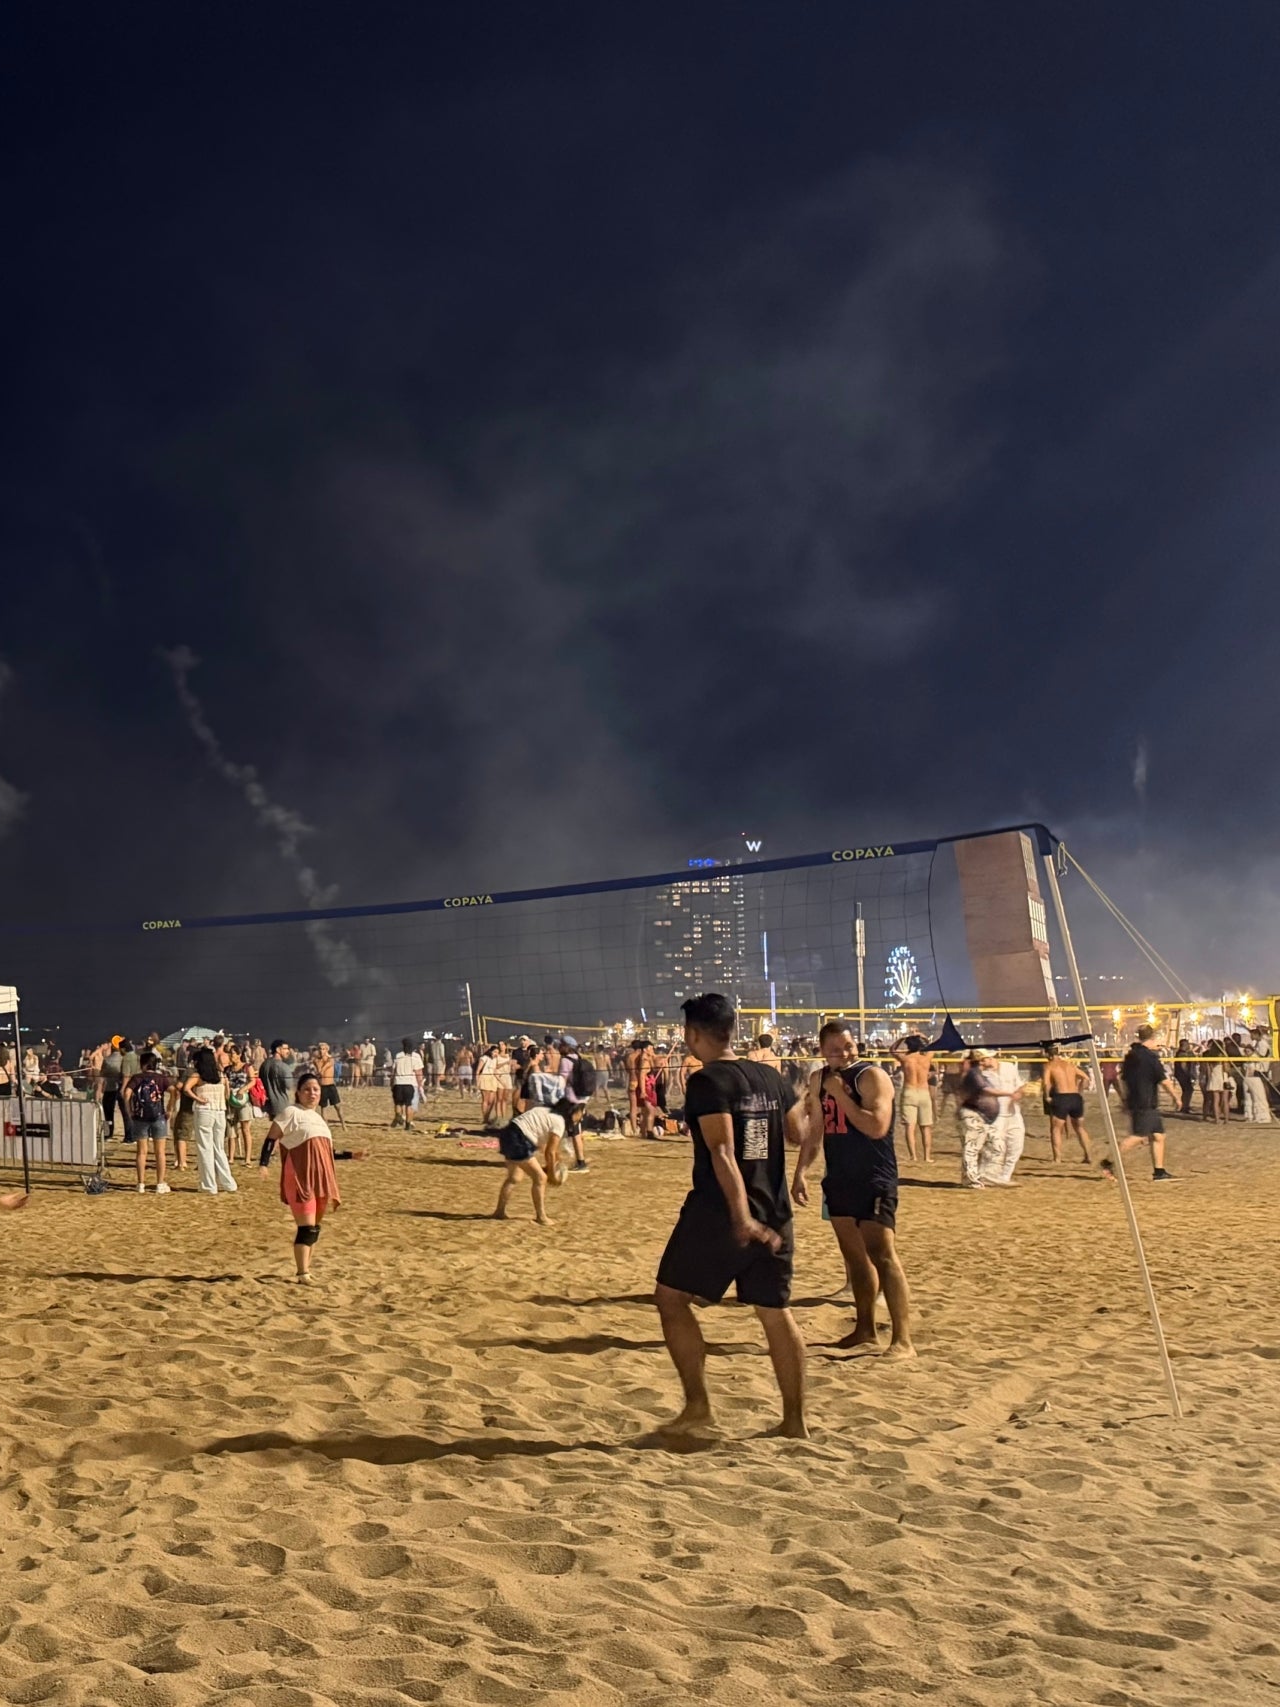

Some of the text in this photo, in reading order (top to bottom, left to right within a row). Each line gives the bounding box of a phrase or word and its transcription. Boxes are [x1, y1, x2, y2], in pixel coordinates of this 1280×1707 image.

[745, 840, 762, 852] W
[831, 846, 895, 862] COPAYA
[443, 895, 494, 908] COPAYA
[142, 919, 182, 930] COPAYA
